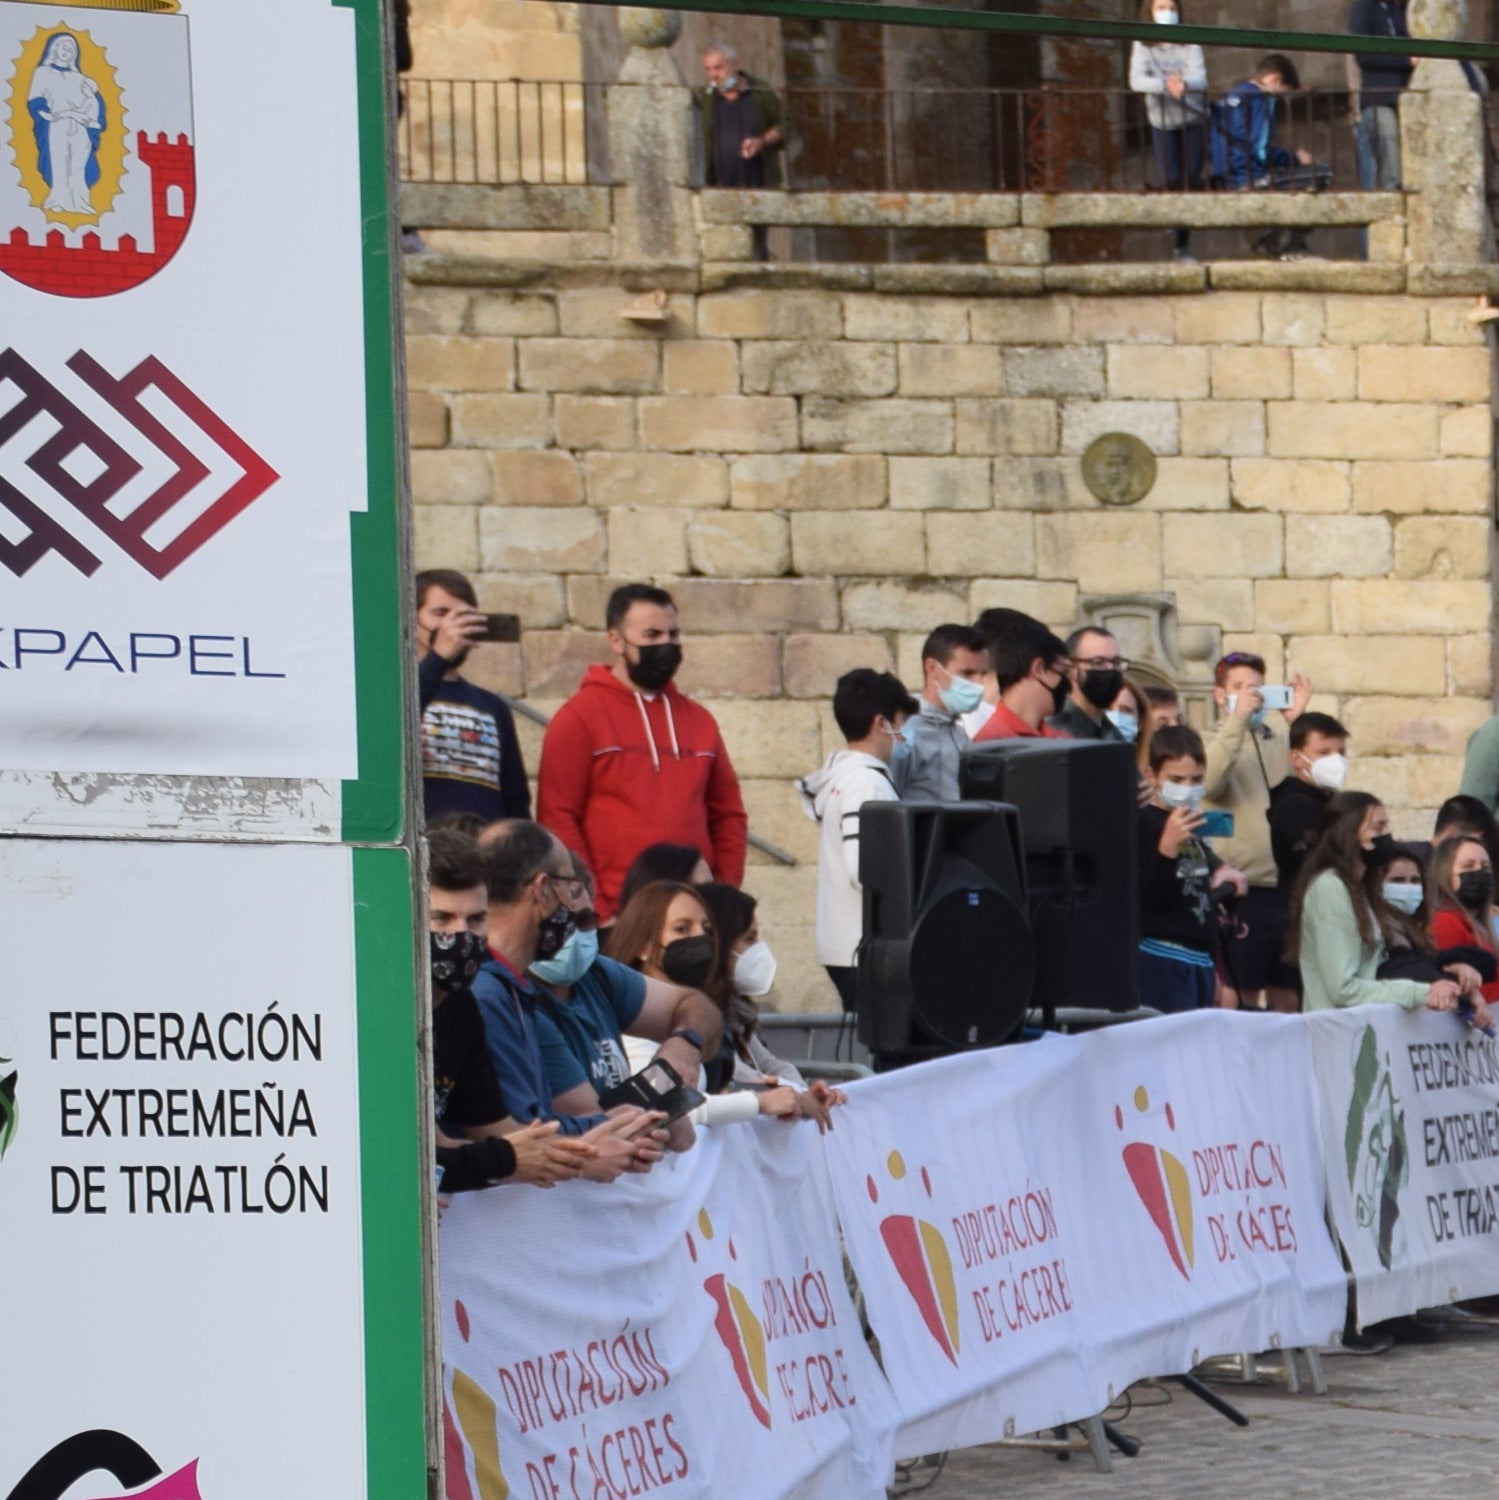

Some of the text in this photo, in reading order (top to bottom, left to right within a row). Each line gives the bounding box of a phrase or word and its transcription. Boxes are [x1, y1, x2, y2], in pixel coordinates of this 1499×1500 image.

[0, 628, 286, 679] PAPEL
[49, 1000, 323, 1063] FEDERACIÓN
[60, 1081, 319, 1138] EXTREMEÑA
[51, 1152, 330, 1215] DE TRIATLÓN
[952, 1178, 1059, 1270] DIPUTACIÓN
[1426, 1192, 1455, 1244] DE
[972, 1286, 1003, 1344] DE
[498, 1317, 671, 1435] DIPUTACIÓN
